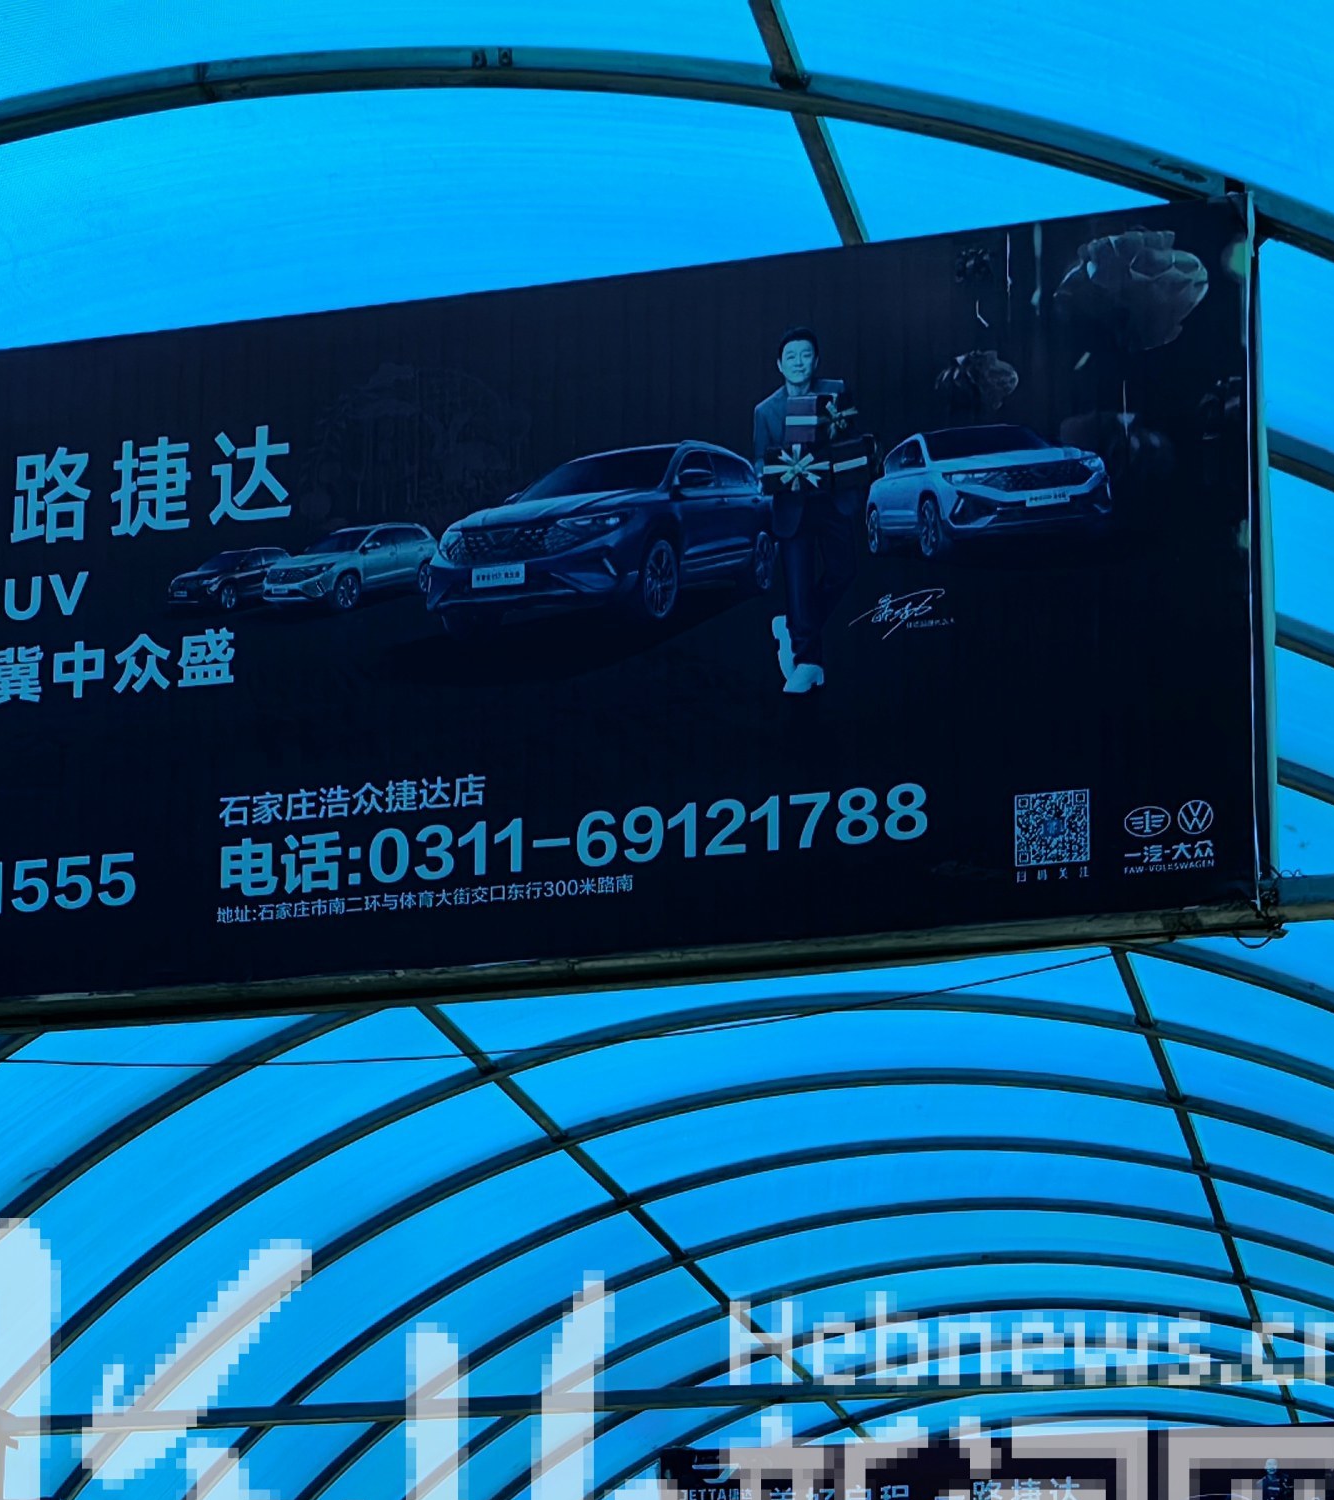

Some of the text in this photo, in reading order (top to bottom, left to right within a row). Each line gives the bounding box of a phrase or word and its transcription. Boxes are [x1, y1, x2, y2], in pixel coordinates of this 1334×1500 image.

[219, 773, 486, 827] 石家庄浩众捷达店
